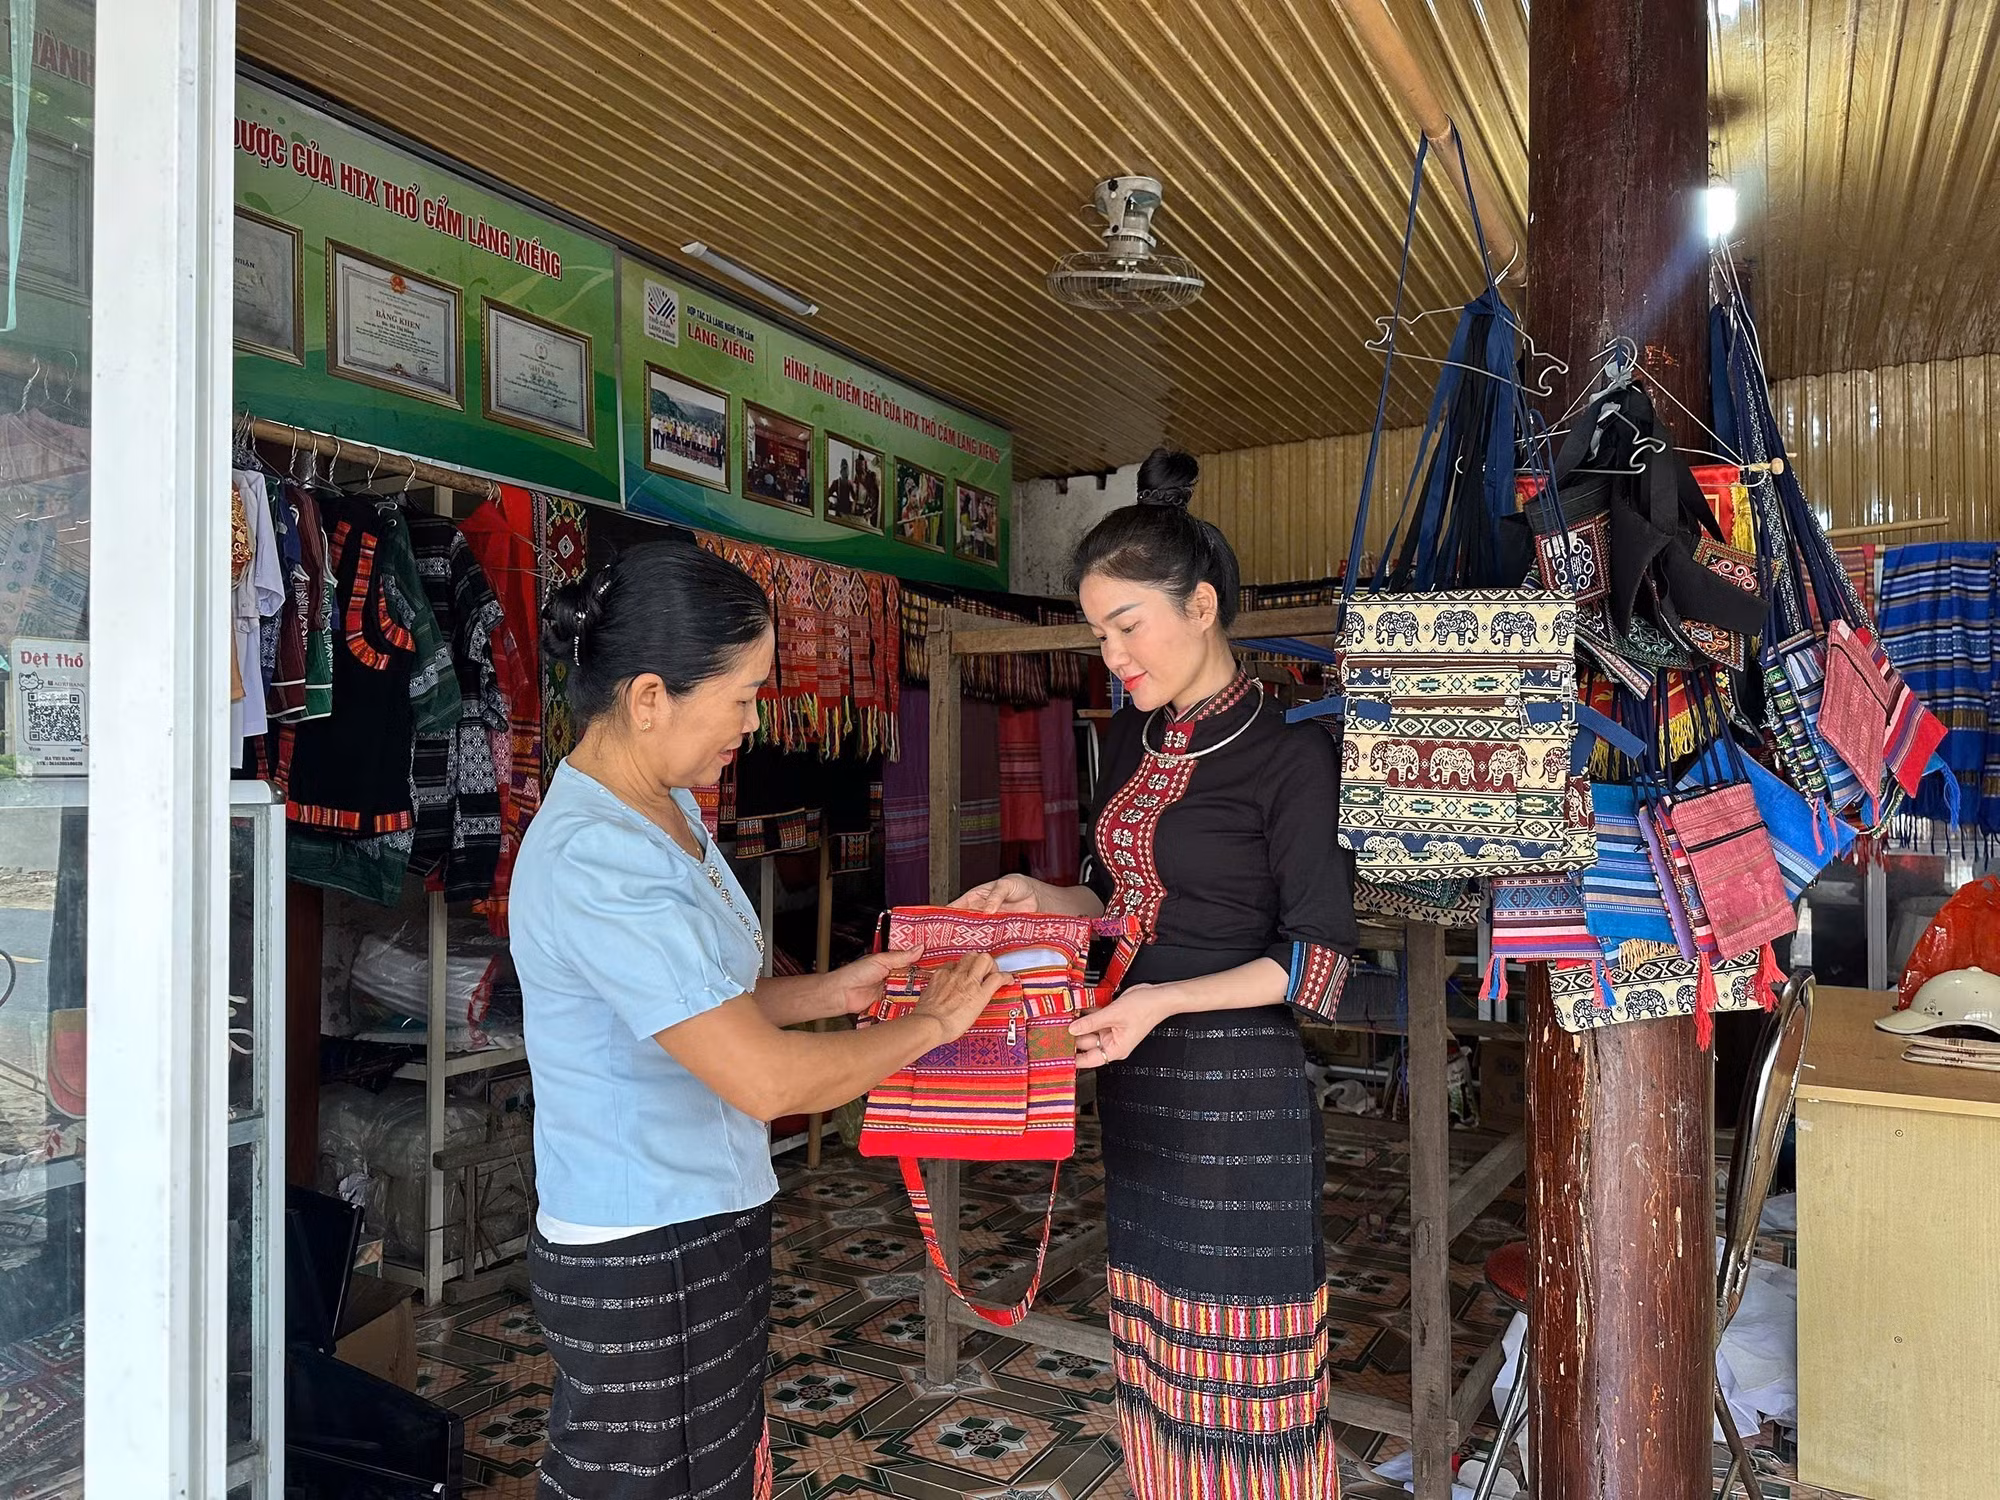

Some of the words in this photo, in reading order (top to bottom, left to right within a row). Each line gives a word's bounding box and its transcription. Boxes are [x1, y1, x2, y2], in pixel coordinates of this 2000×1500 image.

[291, 140, 336, 189] CỦA
[340, 161, 379, 207] HTX
[382, 180, 420, 223] THỔ
[423, 194, 465, 241] CẨM
[468, 214, 512, 261] LÀNG
[399, 317, 421, 331] KHEN
[688, 322, 718, 349] LÀNG
[784, 355, 810, 385] HÌNH
[812, 363, 834, 396] ẢNH
[883, 397, 901, 423] CỦA
[903, 408, 920, 432] HTX
[20, 650, 49, 668] Dệt
[55, 652, 84, 668] thổ
